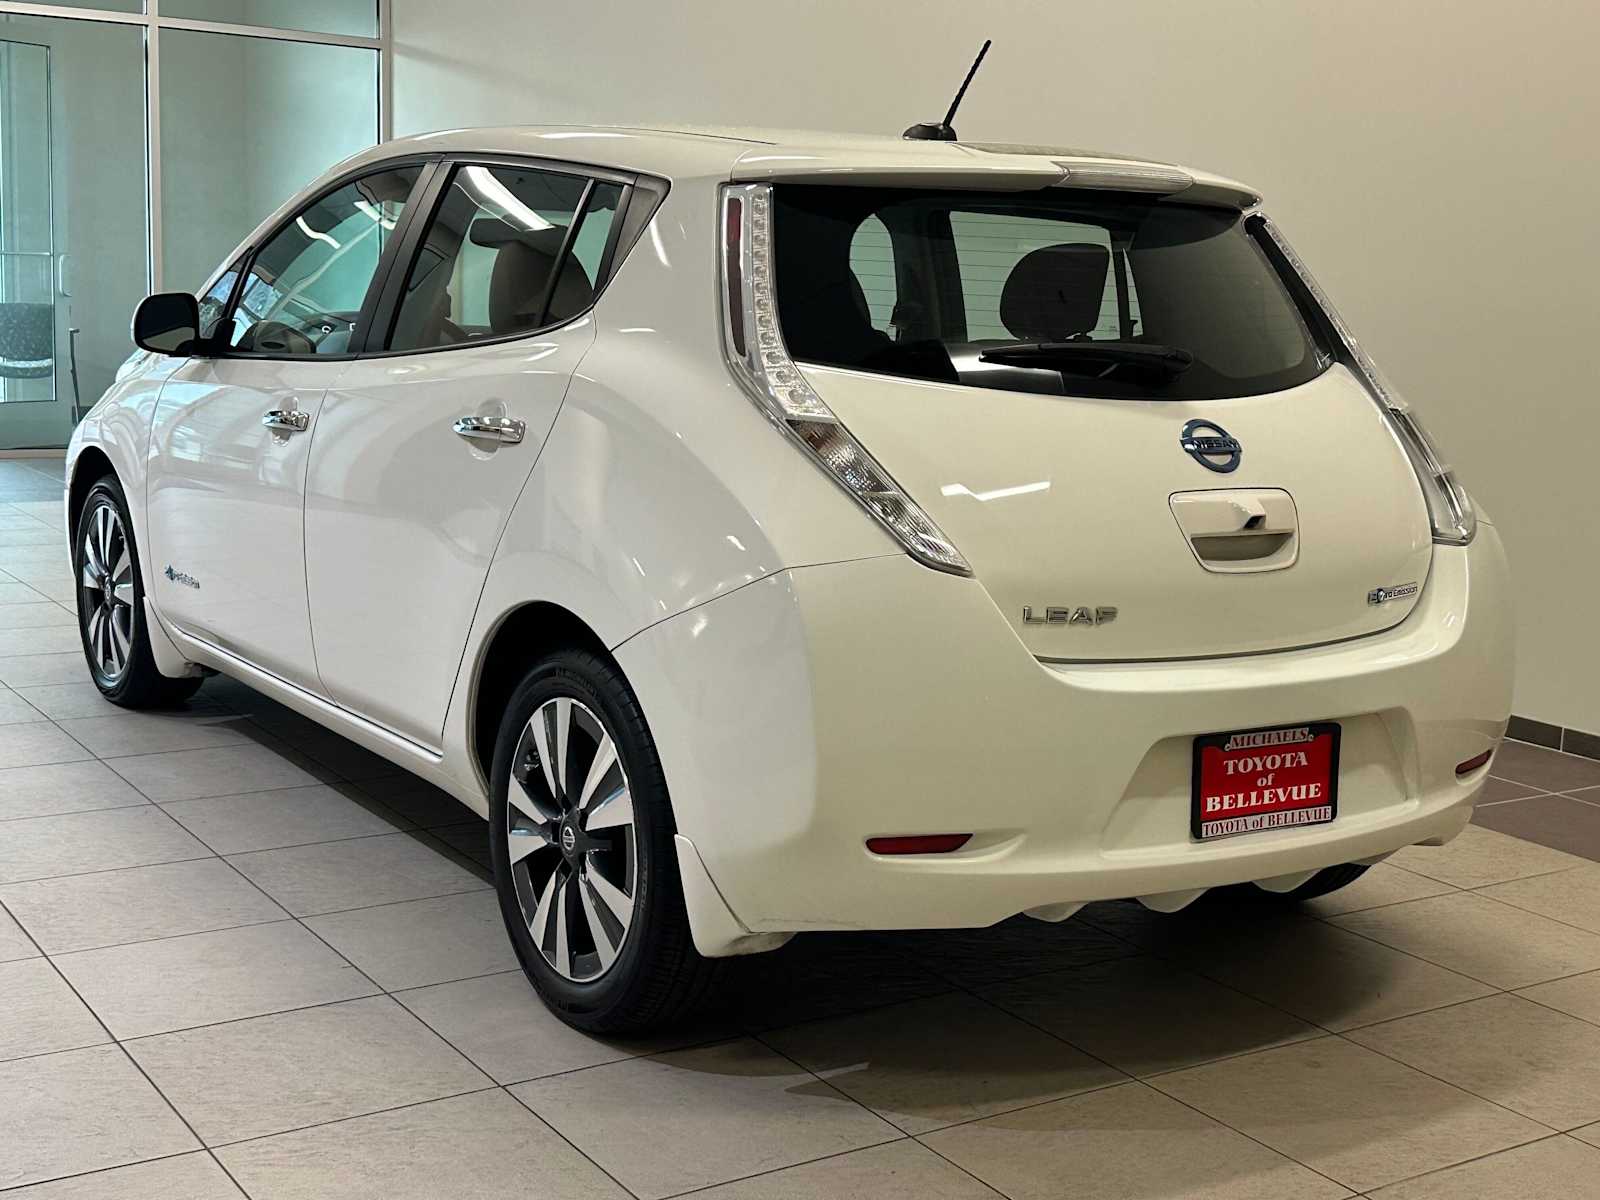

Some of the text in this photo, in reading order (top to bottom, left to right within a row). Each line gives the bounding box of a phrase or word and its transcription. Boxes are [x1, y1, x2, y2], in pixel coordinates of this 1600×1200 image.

[1193, 439, 1239, 449] NISSAN
[1023, 606, 1117, 625] LEAF
[1231, 729, 1307, 748] MICHAELS
[1224, 752, 1308, 775] TOYOTA
[1256, 773, 1275, 787] of
[1206, 783, 1321, 812] BELLEVUE
[1203, 807, 1330, 837] TOYOTA of BELLEVUE
